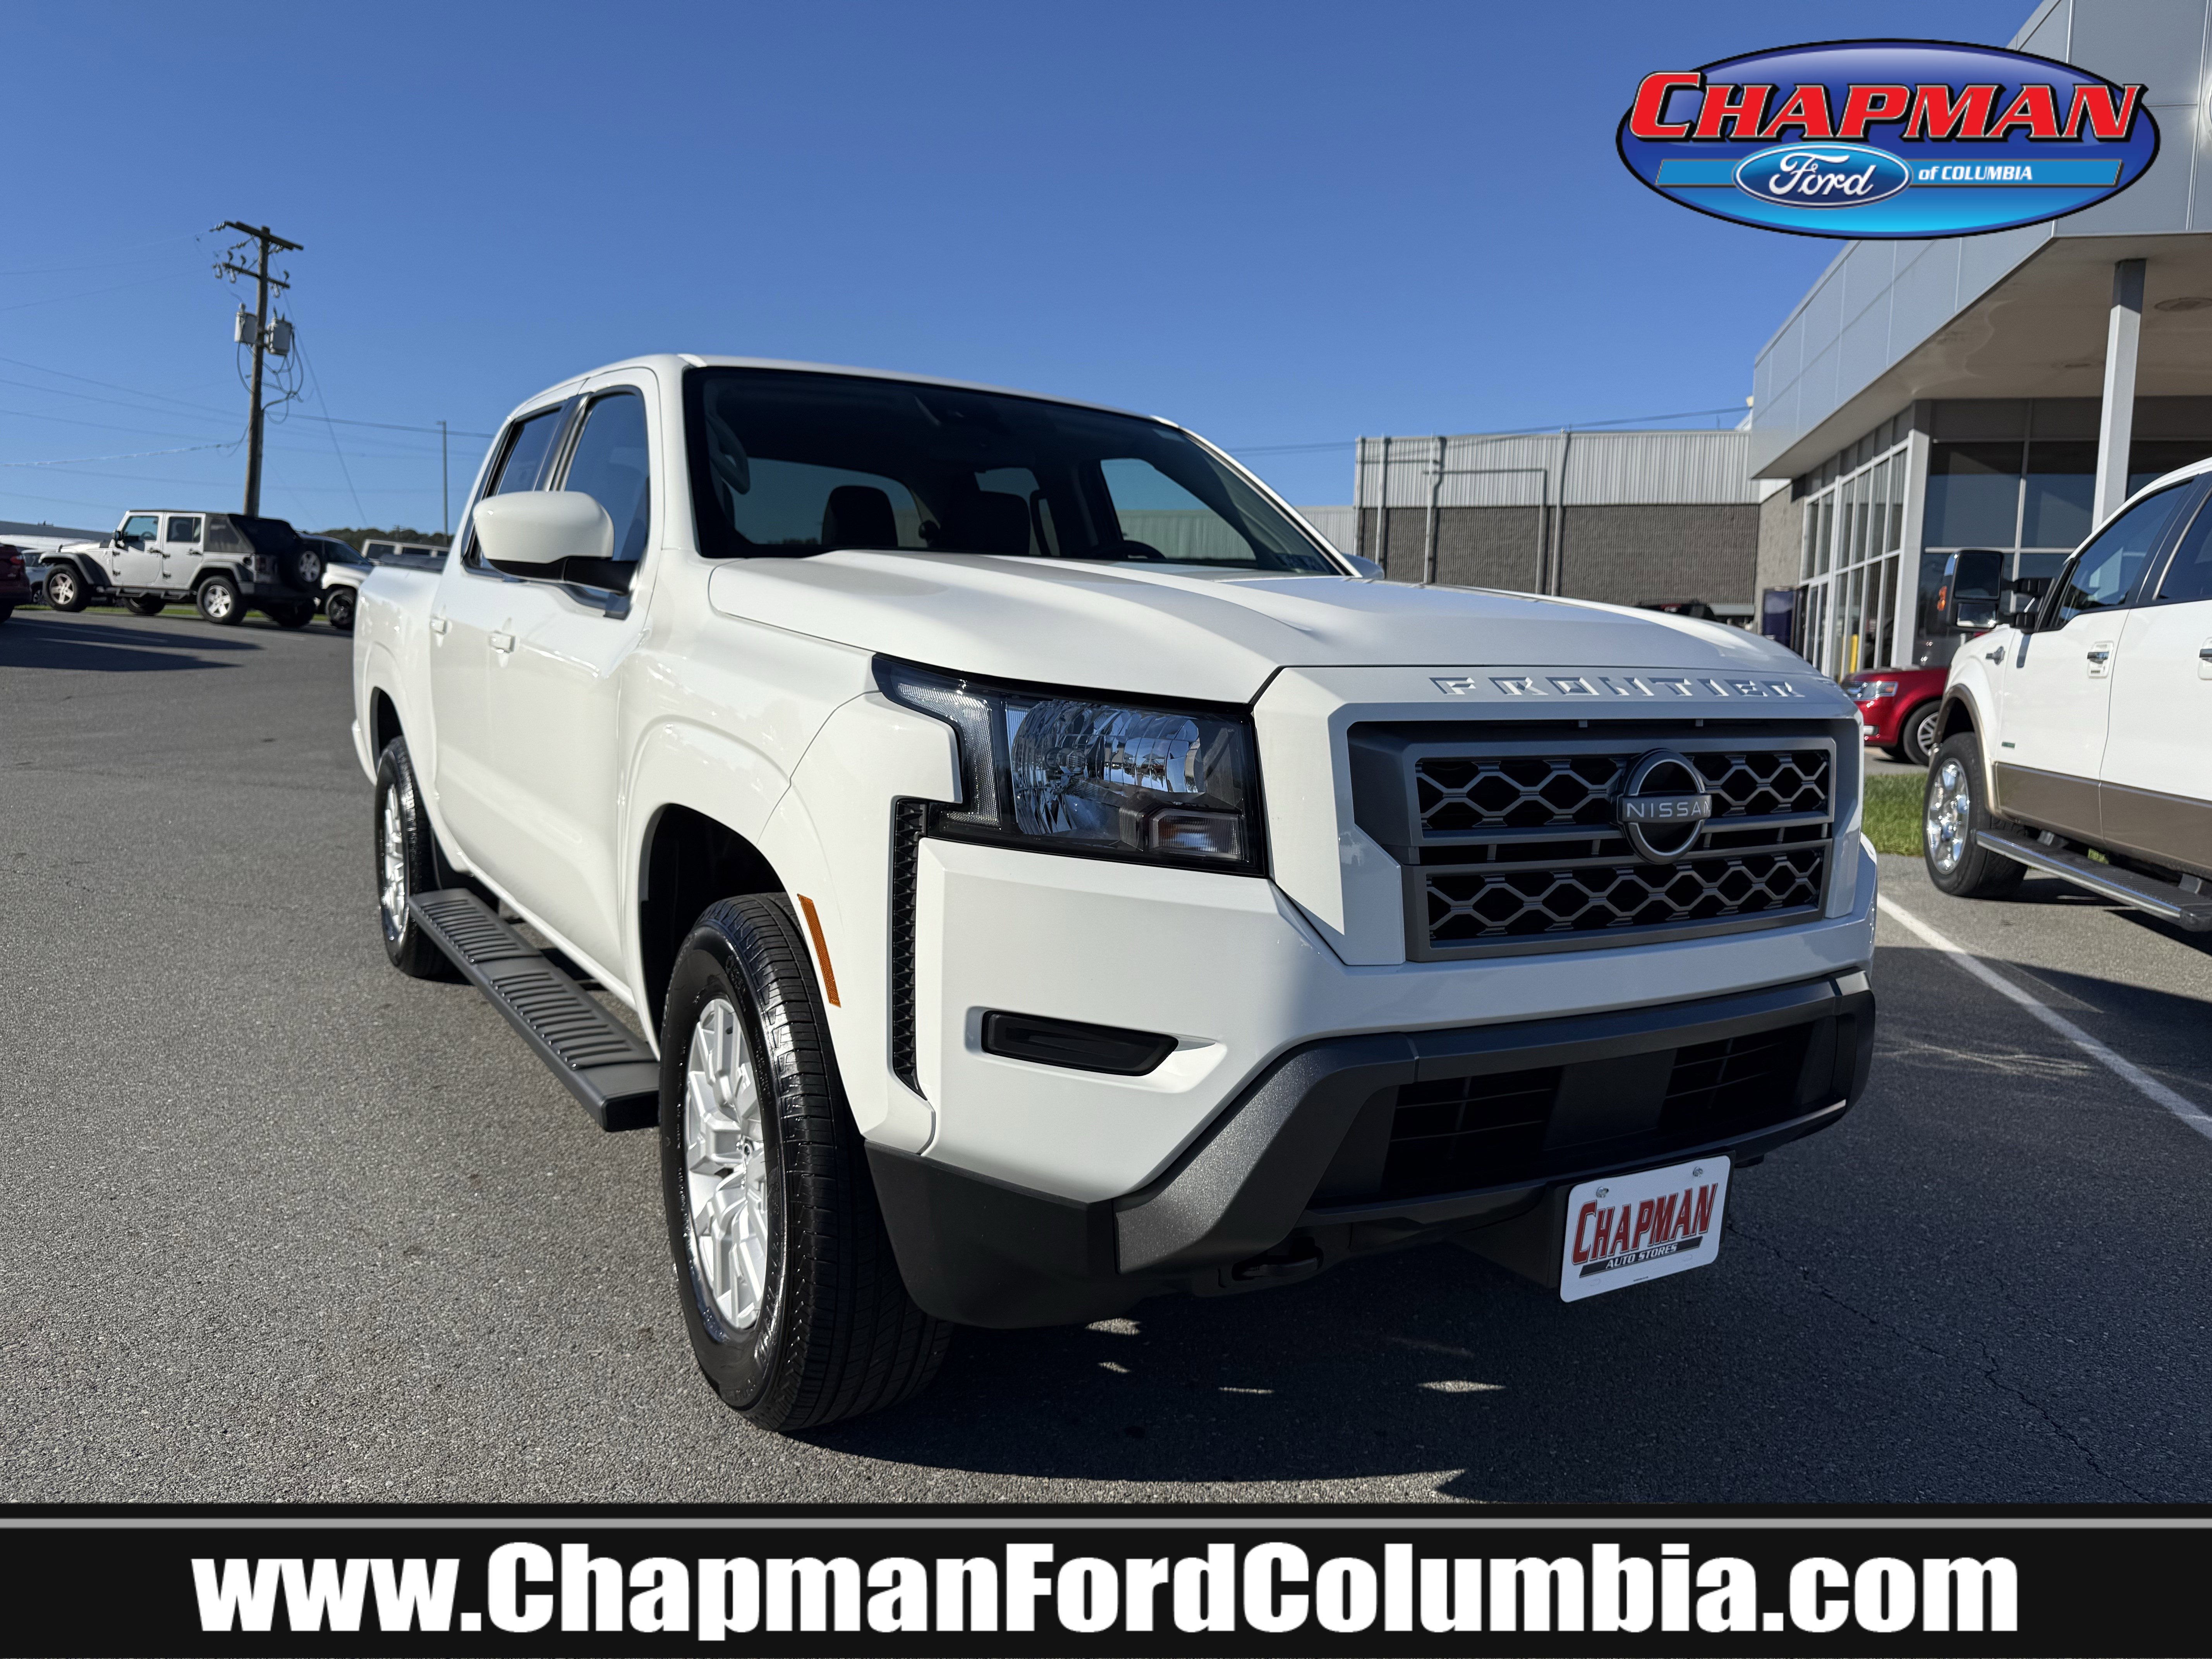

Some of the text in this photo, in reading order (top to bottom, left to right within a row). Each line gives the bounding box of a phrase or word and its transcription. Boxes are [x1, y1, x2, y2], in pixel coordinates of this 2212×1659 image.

[1429, 677, 1805, 697] FRONTIER
[1626, 800, 1711, 818] NISSAN
[1571, 1183, 1718, 1266] CHAPMAN
[1605, 1242, 1678, 1269] AUTO STORES
